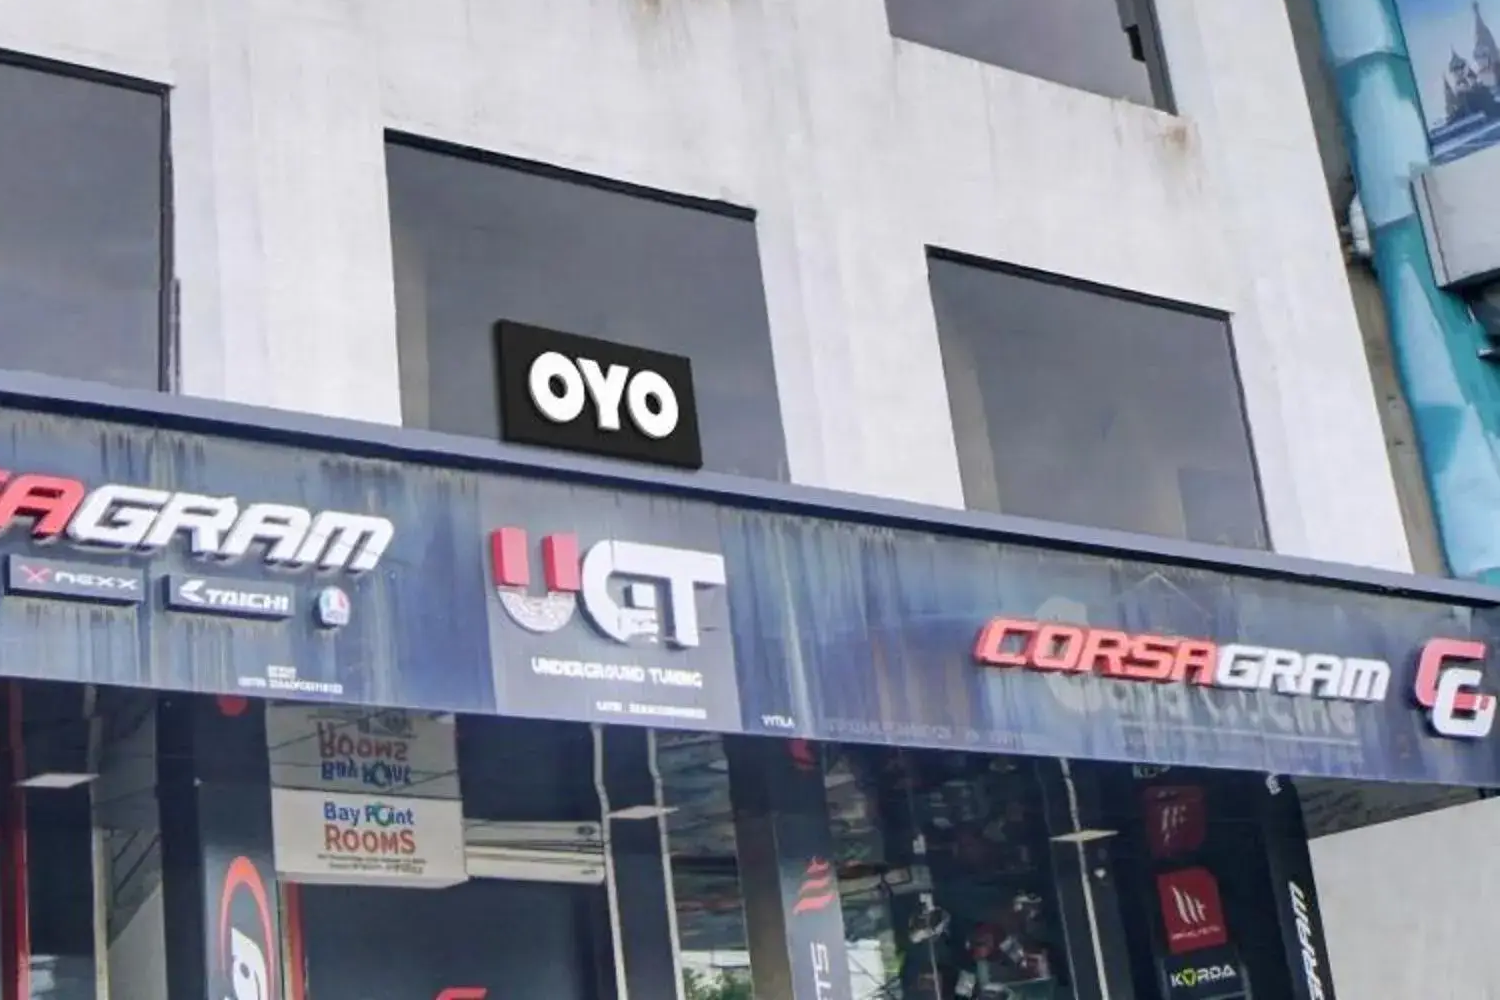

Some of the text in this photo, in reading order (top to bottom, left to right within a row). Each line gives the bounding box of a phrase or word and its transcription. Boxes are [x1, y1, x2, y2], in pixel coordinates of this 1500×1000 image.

[529, 351, 679, 438] OYO
[531, 656, 703, 689] UNDERGROUND TUNING
[972, 615, 1392, 701] CORSAGRAM
[323, 801, 414, 827] Bay Point
[324, 824, 416, 855] ROOMS
[1170, 963, 1236, 988] KORDA
